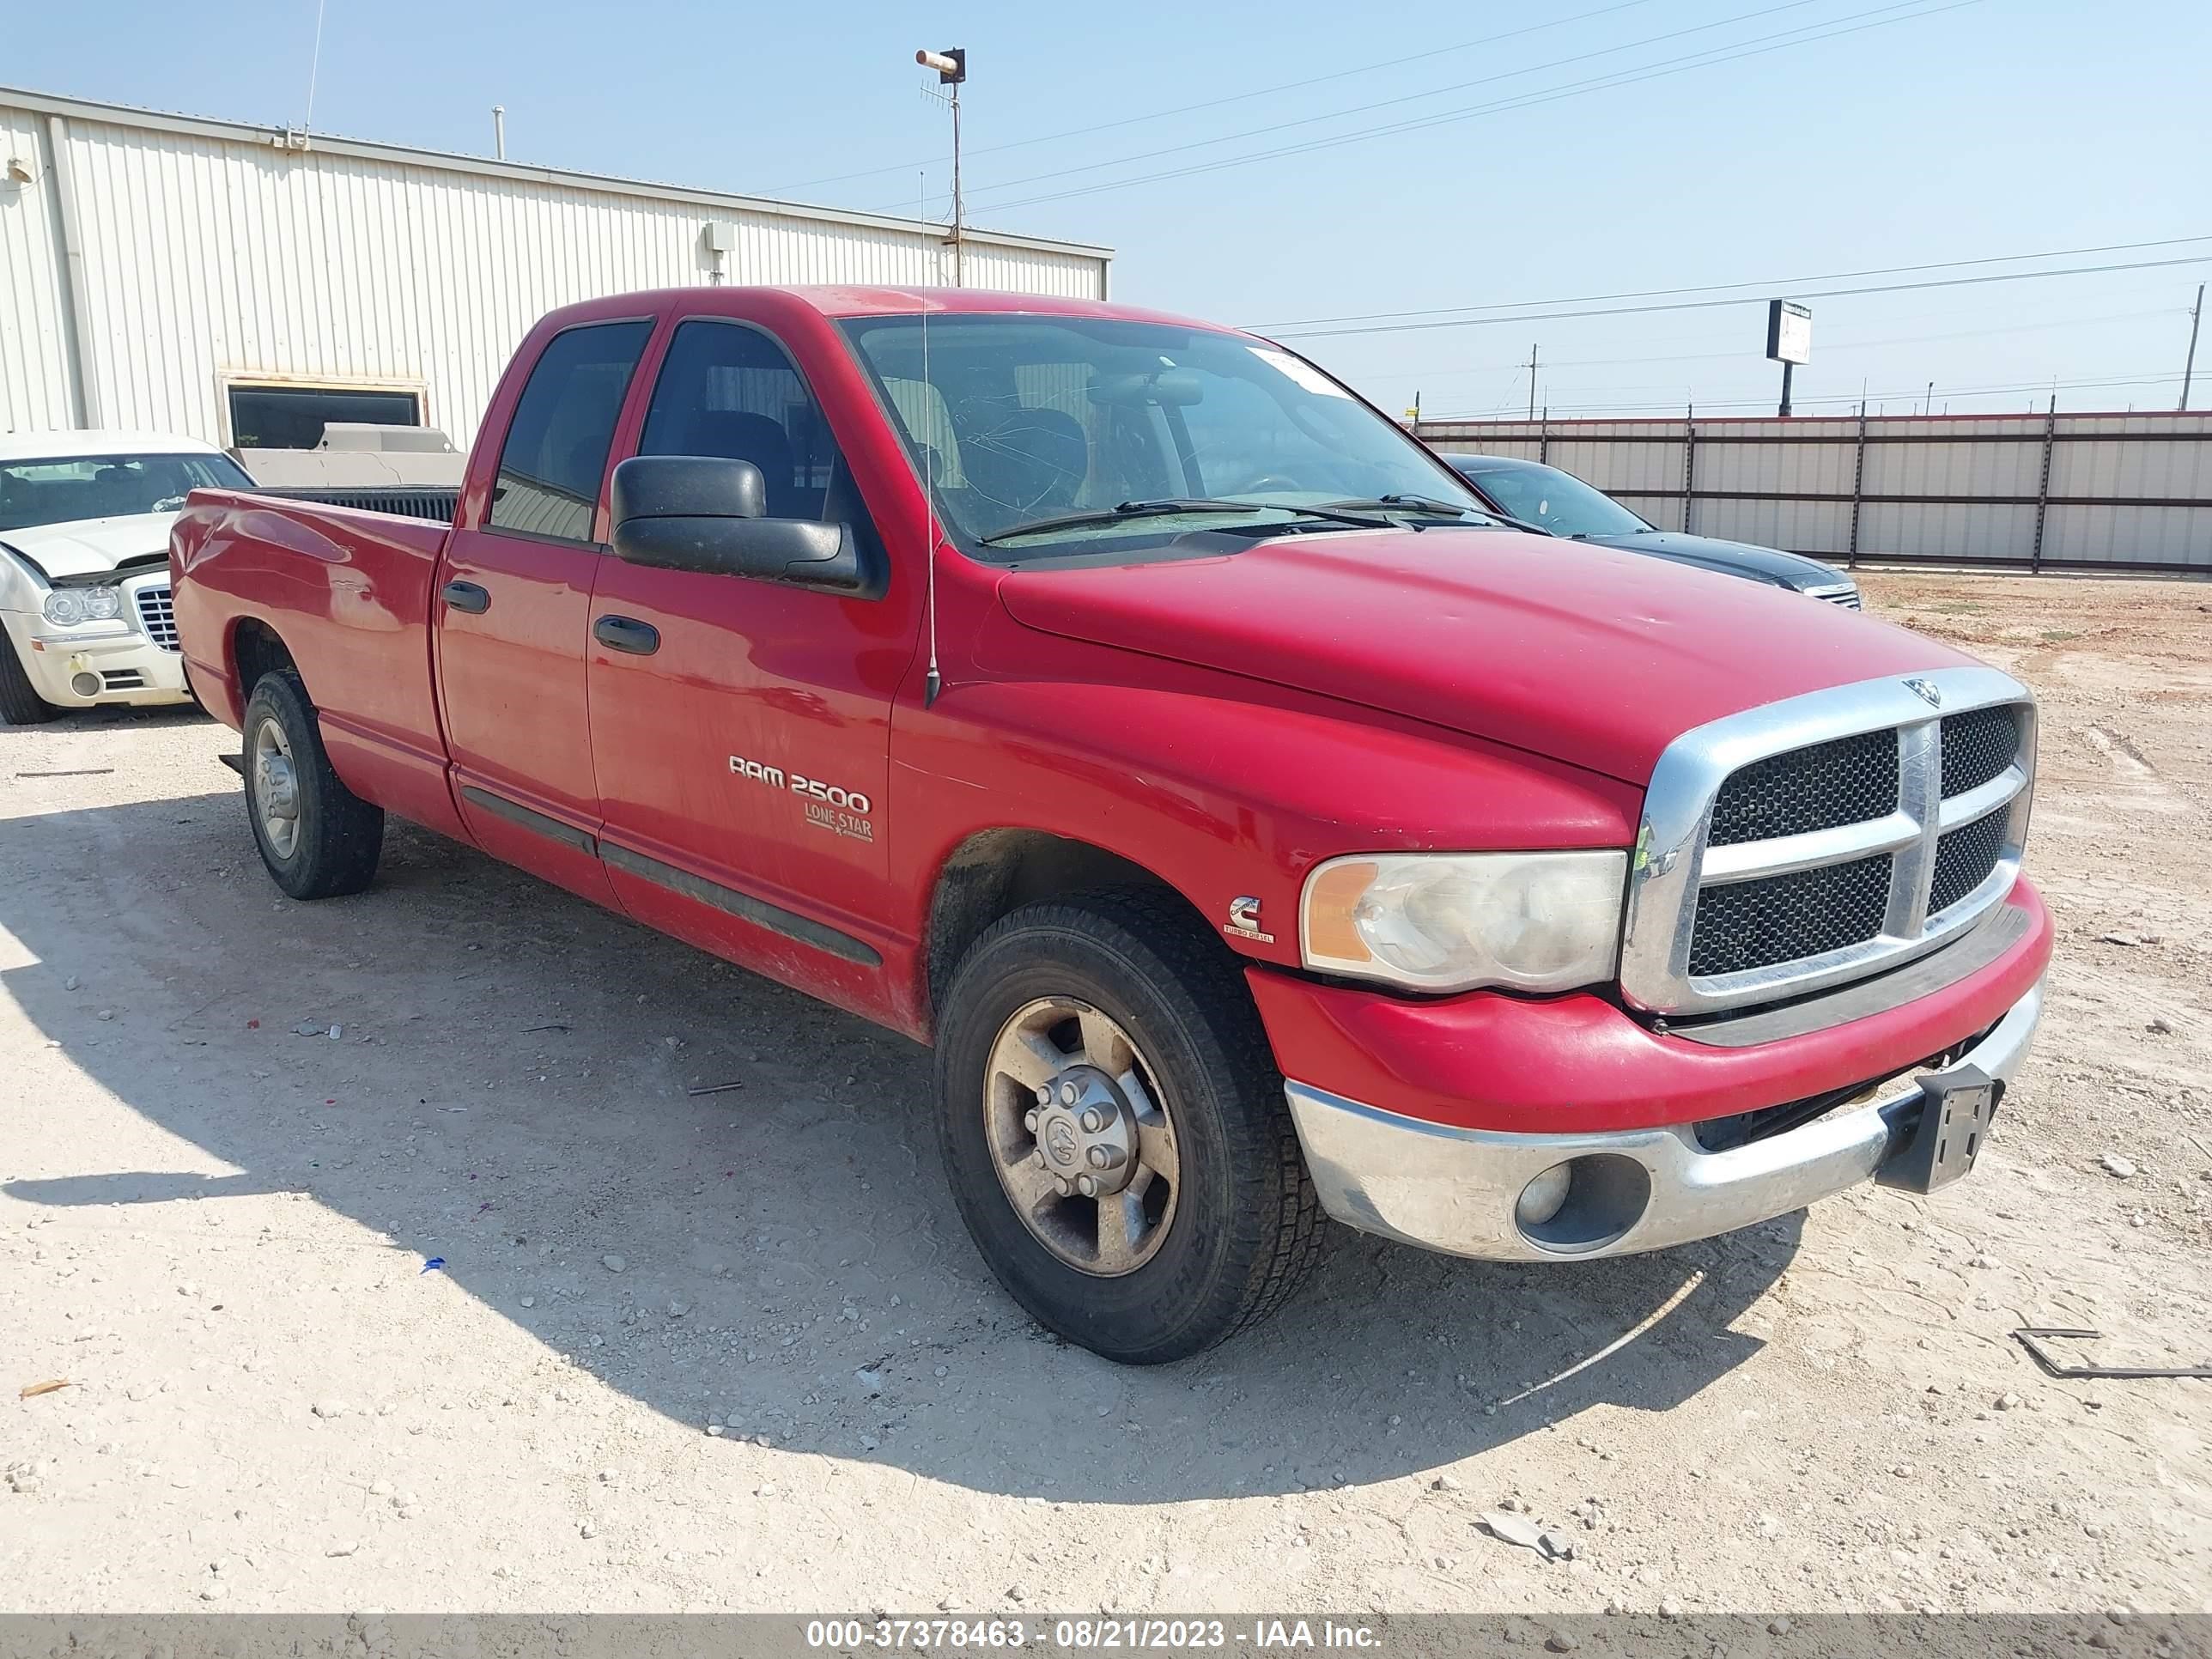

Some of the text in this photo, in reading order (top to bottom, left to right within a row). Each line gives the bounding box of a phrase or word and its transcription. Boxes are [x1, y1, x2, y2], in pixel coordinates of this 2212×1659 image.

[729, 756, 871, 814] RAM 2500
[805, 803, 872, 836] LONE STAR
[1225, 927, 1272, 942] TURBO DIESEL
